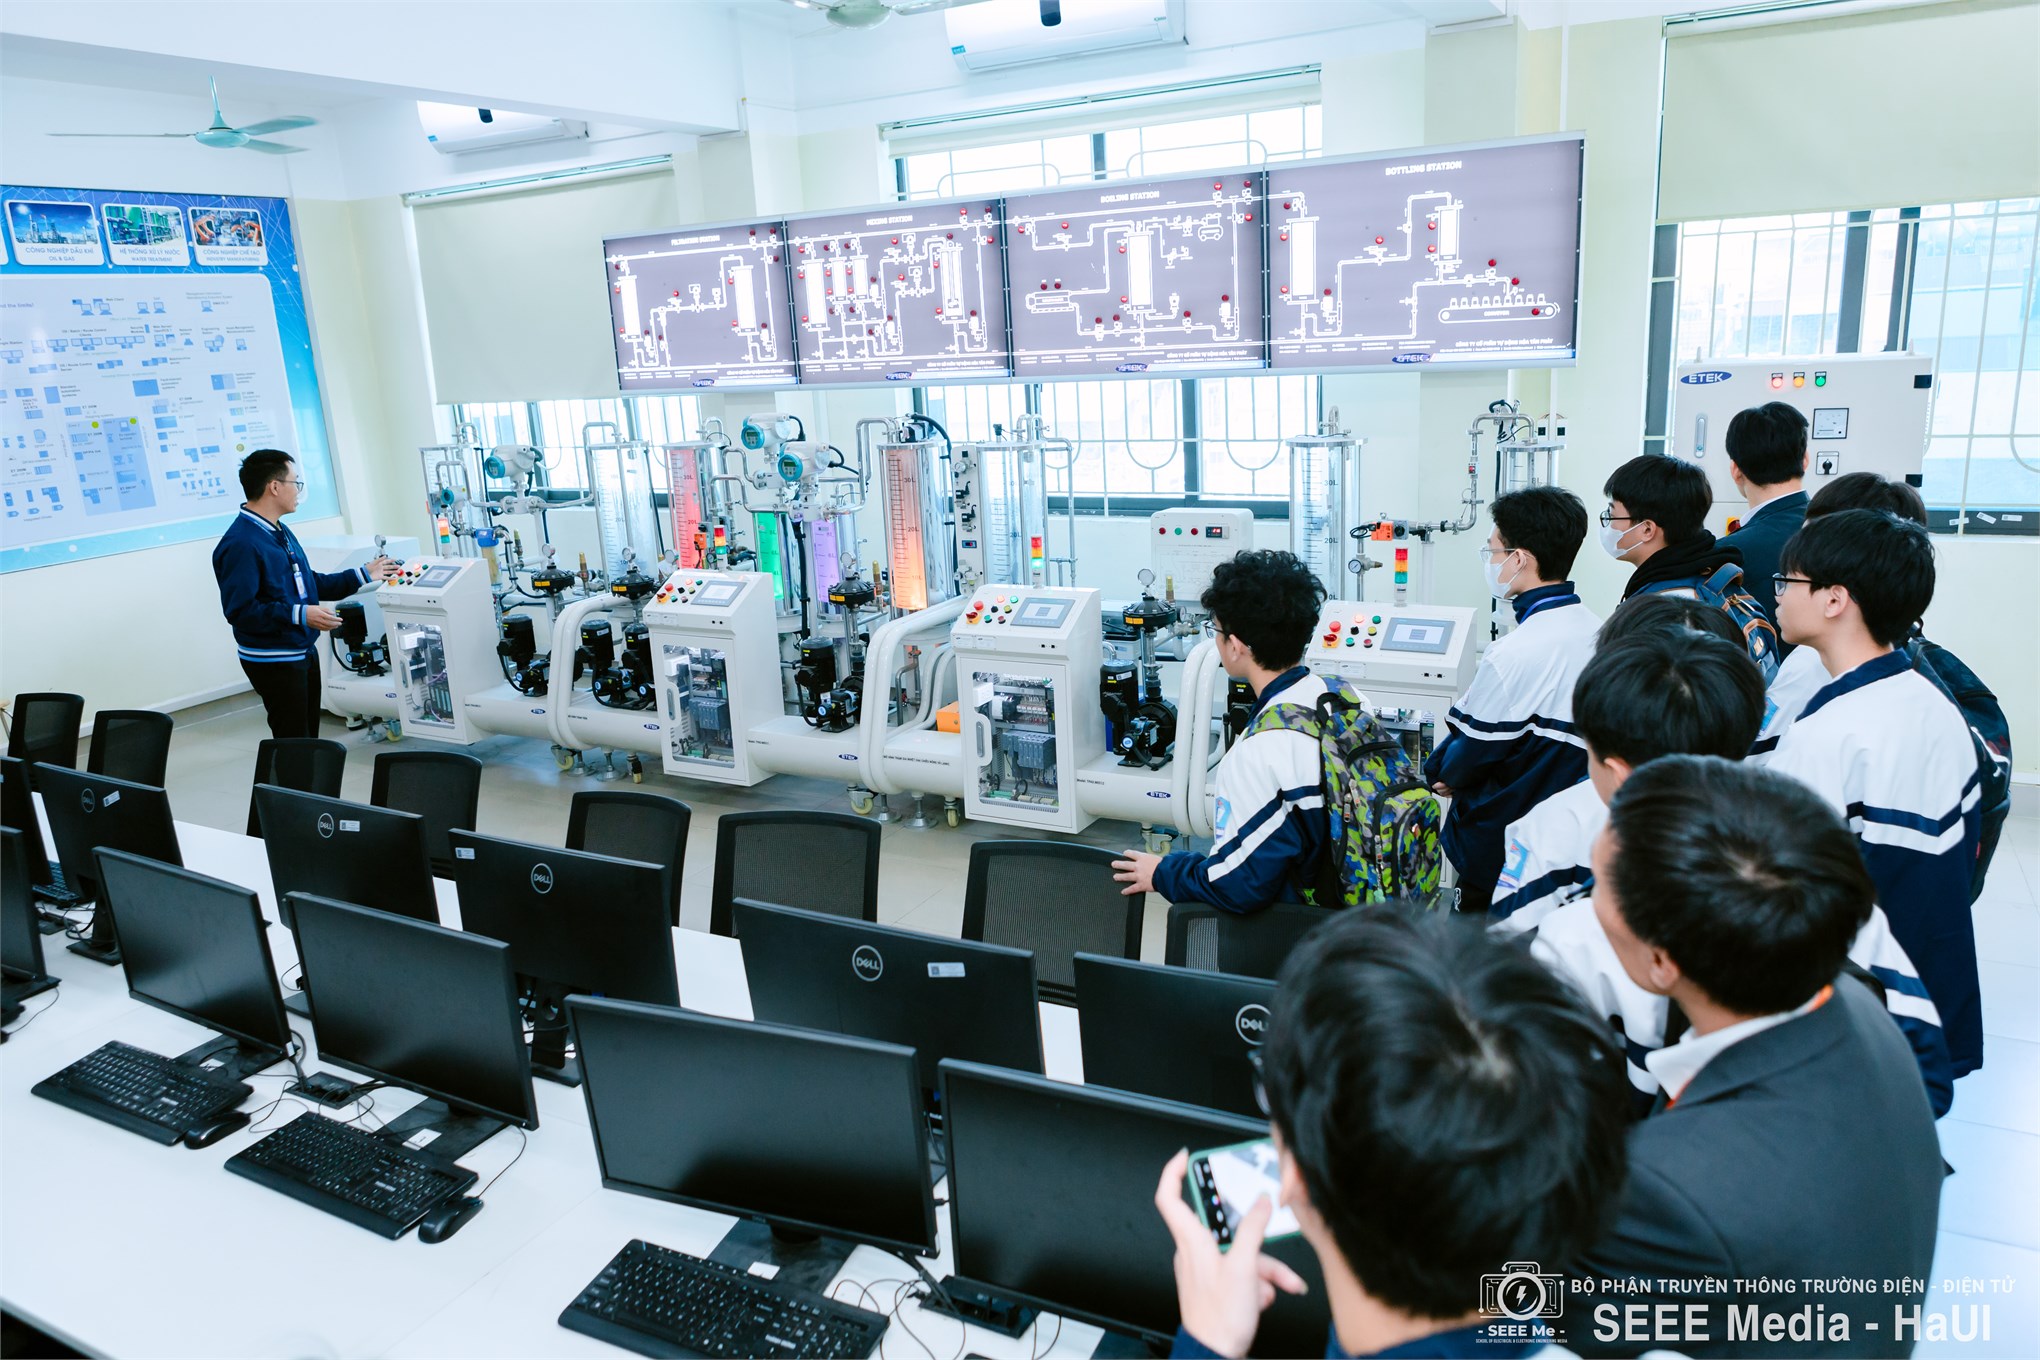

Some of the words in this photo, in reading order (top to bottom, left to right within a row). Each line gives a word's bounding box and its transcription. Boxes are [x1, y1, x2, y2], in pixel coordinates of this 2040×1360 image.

[1385, 164, 1425, 176] BOTTLING
[1426, 160, 1463, 172] STATION
[1100, 194, 1129, 204] BOILING
[1130, 190, 1160, 201] STATION
[888, 214, 913, 224] STATION
[1688, 373, 1724, 383] ETEK
[320, 821, 332, 830] DELL
[534, 874, 551, 884] DELL
[856, 957, 880, 970] DELL
